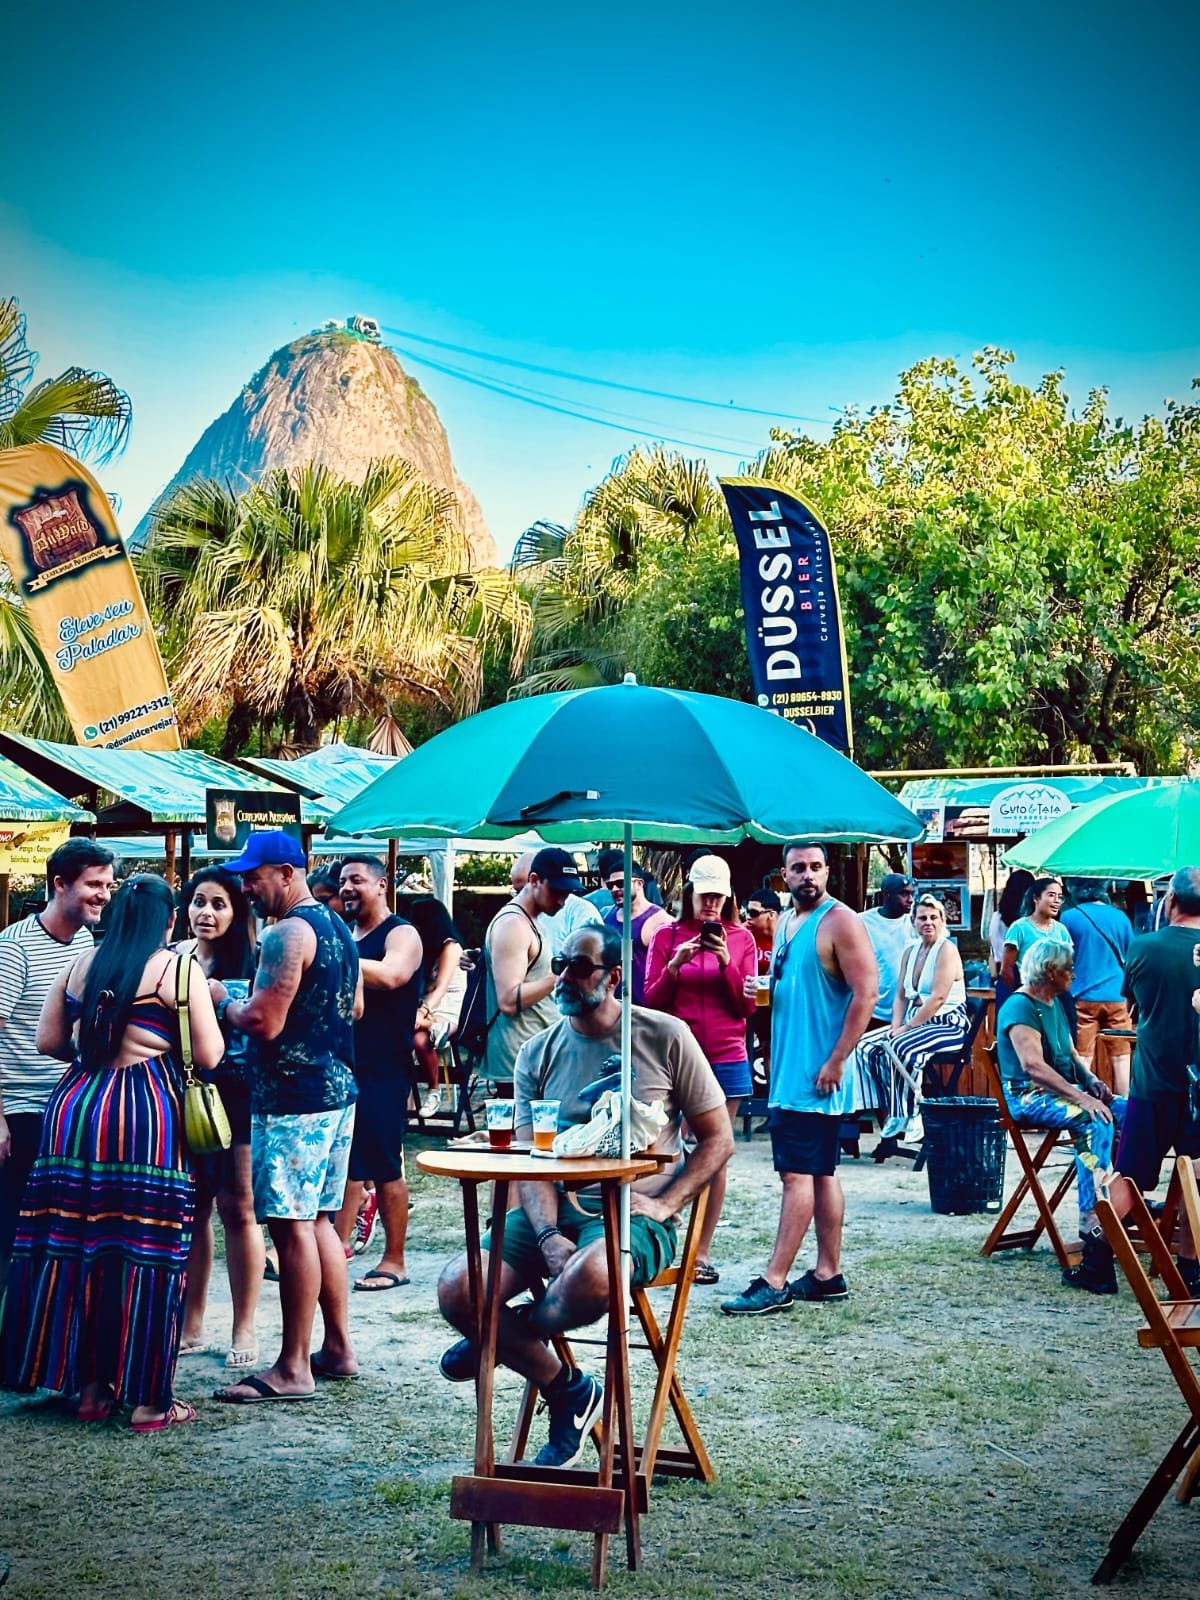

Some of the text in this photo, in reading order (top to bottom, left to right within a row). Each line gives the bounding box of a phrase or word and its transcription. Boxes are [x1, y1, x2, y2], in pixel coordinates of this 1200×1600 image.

[748, 501, 802, 681] DÜSSEL
[797, 555, 813, 611] BIER
[59, 601, 133, 643] Eleve seu
[817, 590, 829, 642] Cerveja
[55, 624, 139, 671] Paladar
[98, 696, 171, 735] (21) 99221-312
